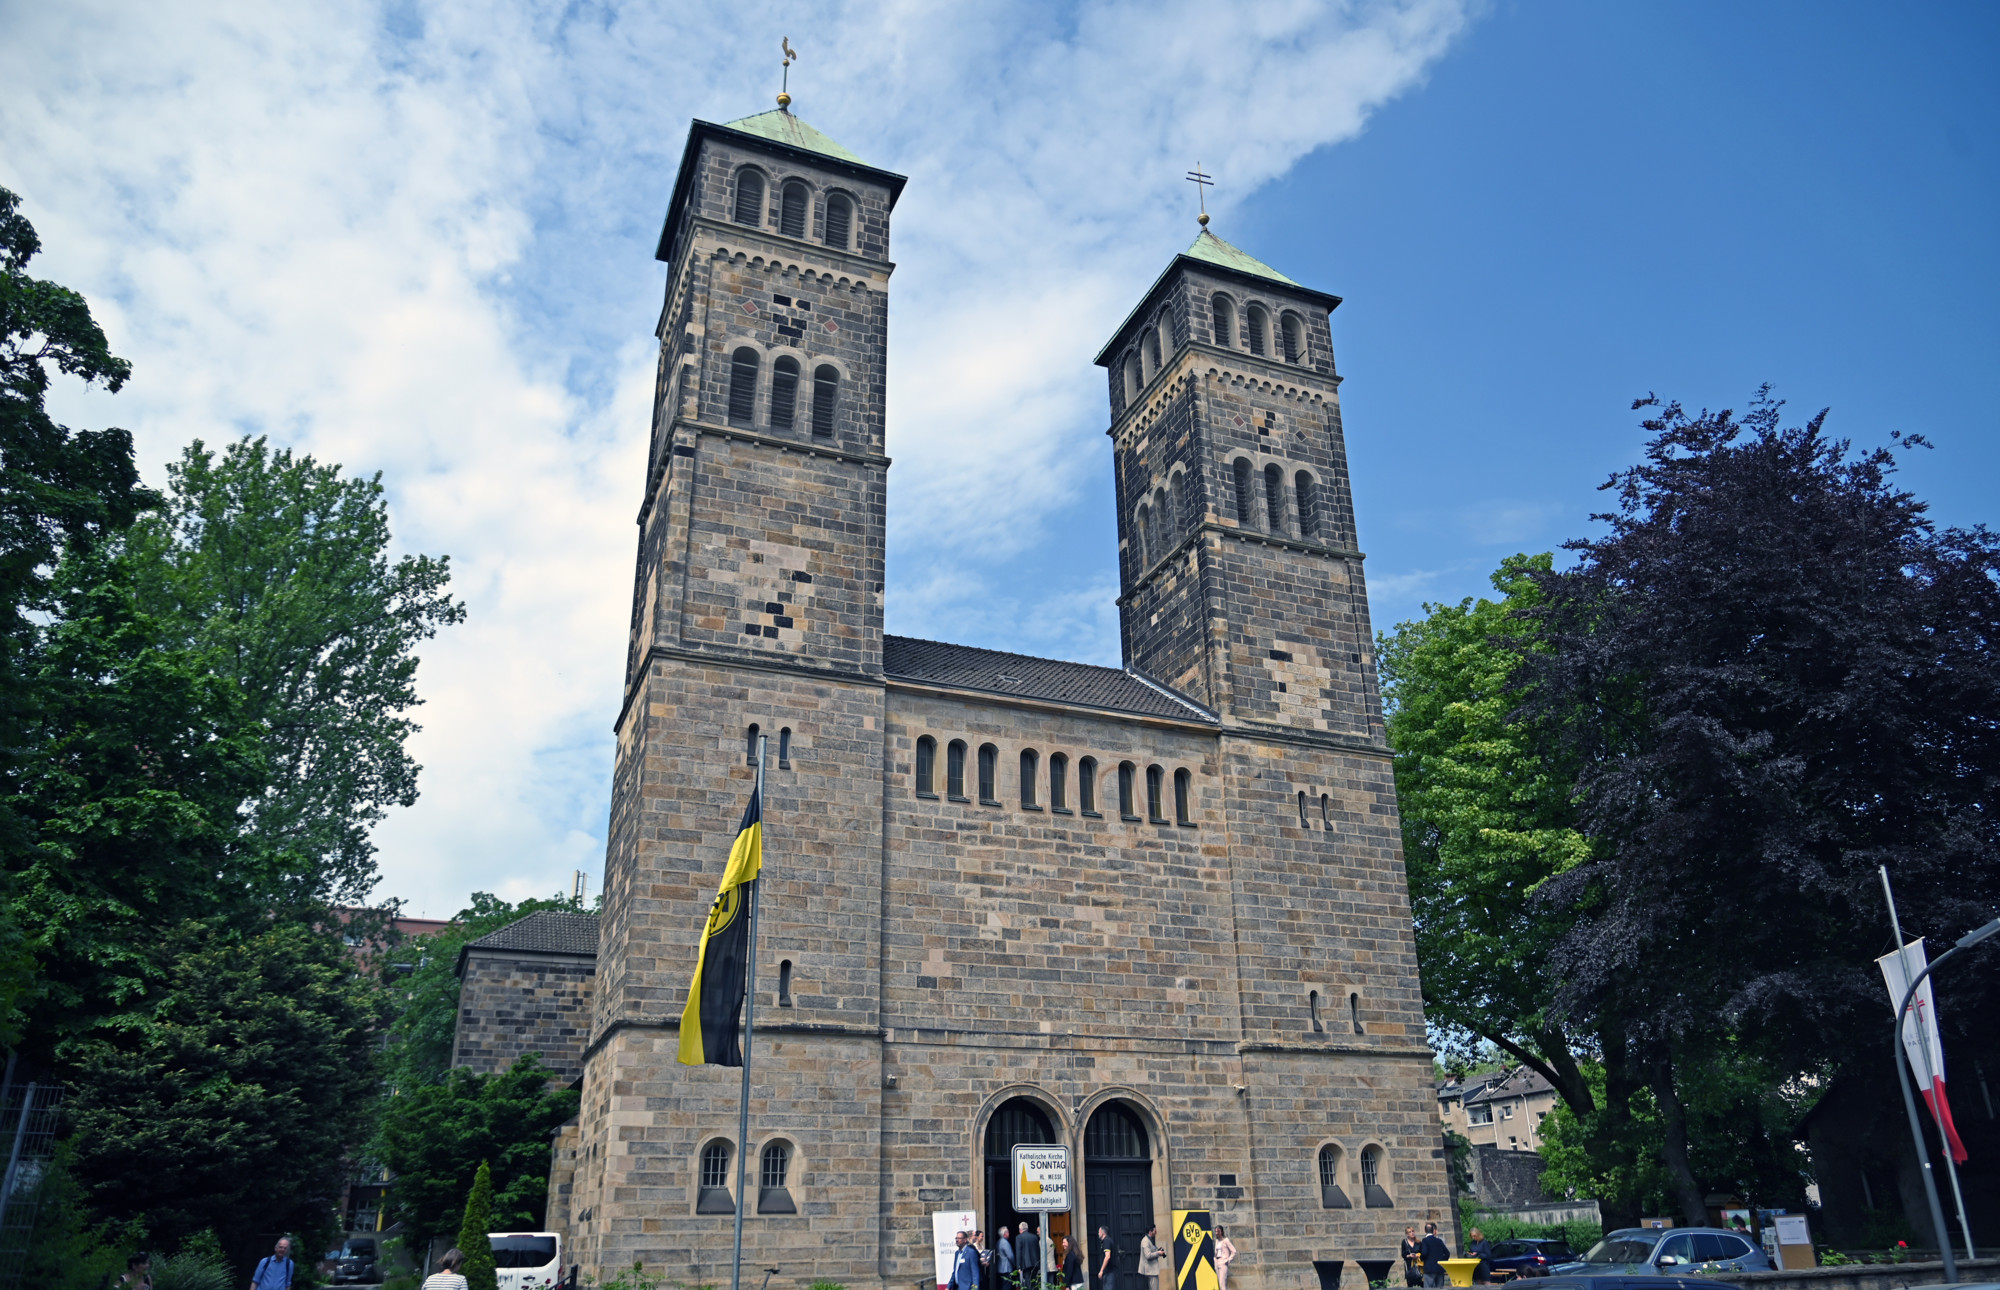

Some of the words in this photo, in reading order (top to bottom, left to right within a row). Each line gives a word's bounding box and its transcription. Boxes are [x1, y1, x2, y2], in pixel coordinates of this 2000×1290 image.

[1030, 1160, 1066, 1170] SONNTAG
[1031, 1197, 1062, 1206] Dreifaltigkeit
[1185, 1224, 1200, 1237] BVB
